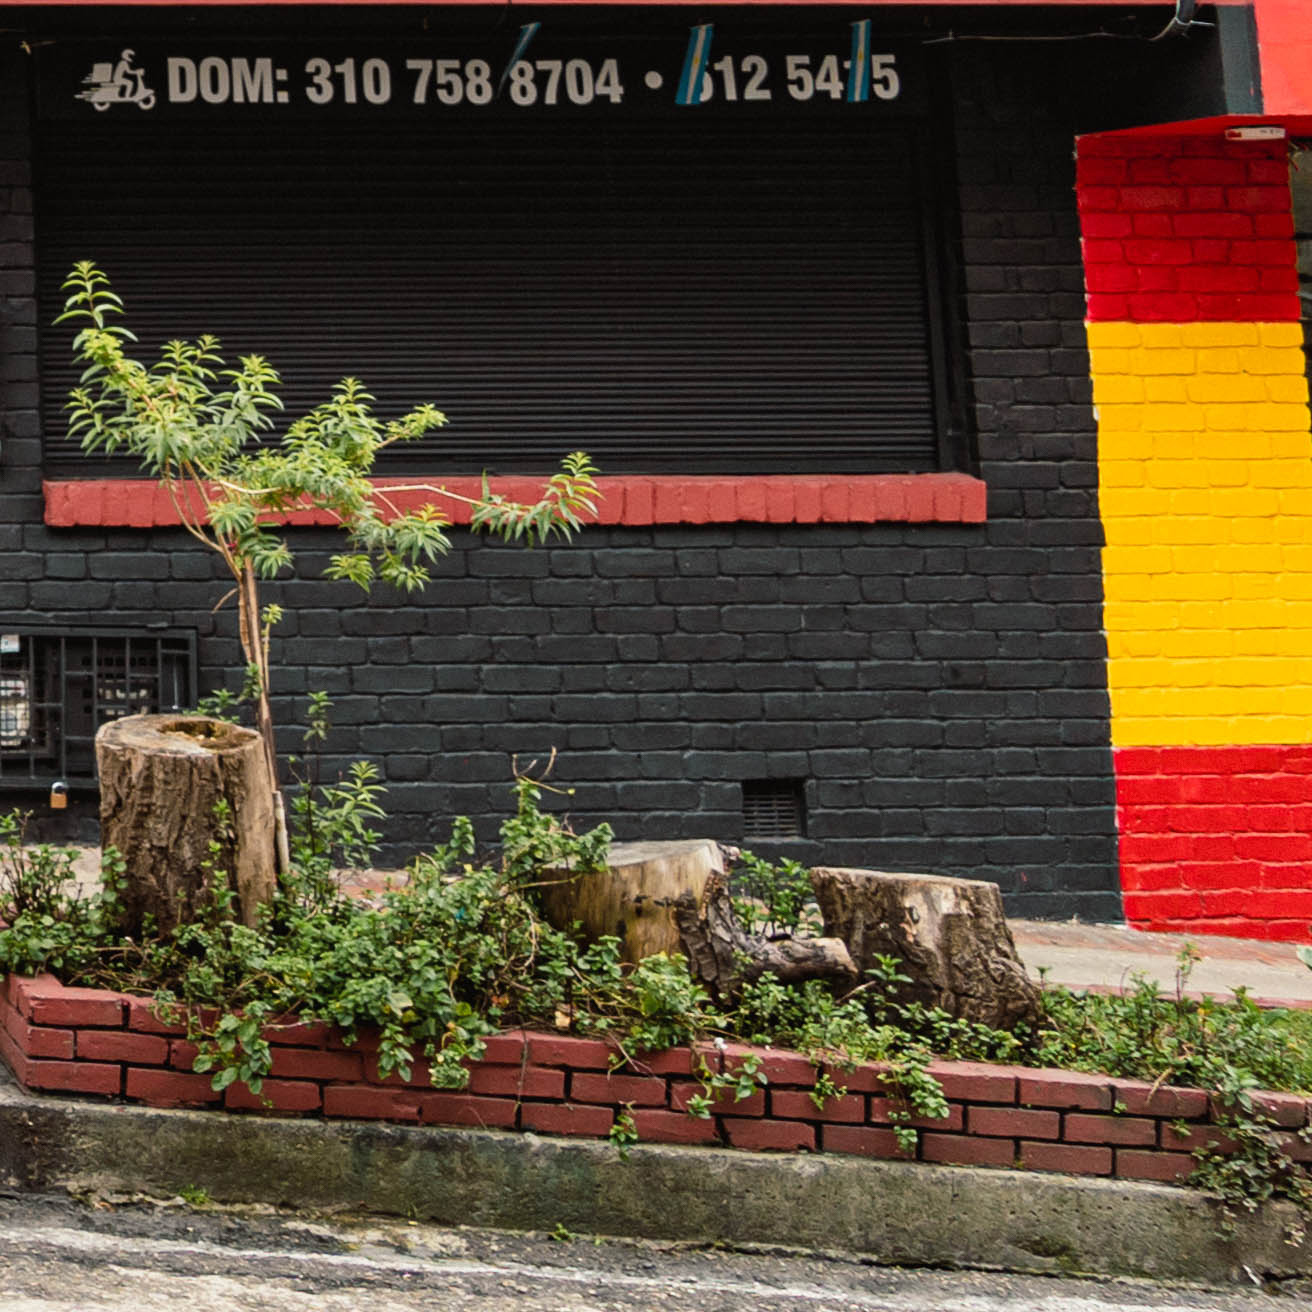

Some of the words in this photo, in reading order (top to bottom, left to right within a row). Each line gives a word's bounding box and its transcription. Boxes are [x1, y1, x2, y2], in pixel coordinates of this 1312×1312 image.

[167, 56, 290, 104] DOM:
[305, 58, 392, 105] 310
[406, 59, 493, 106] 758
[508, 59, 625, 107] 8704
[785, 54, 901, 101] 545
